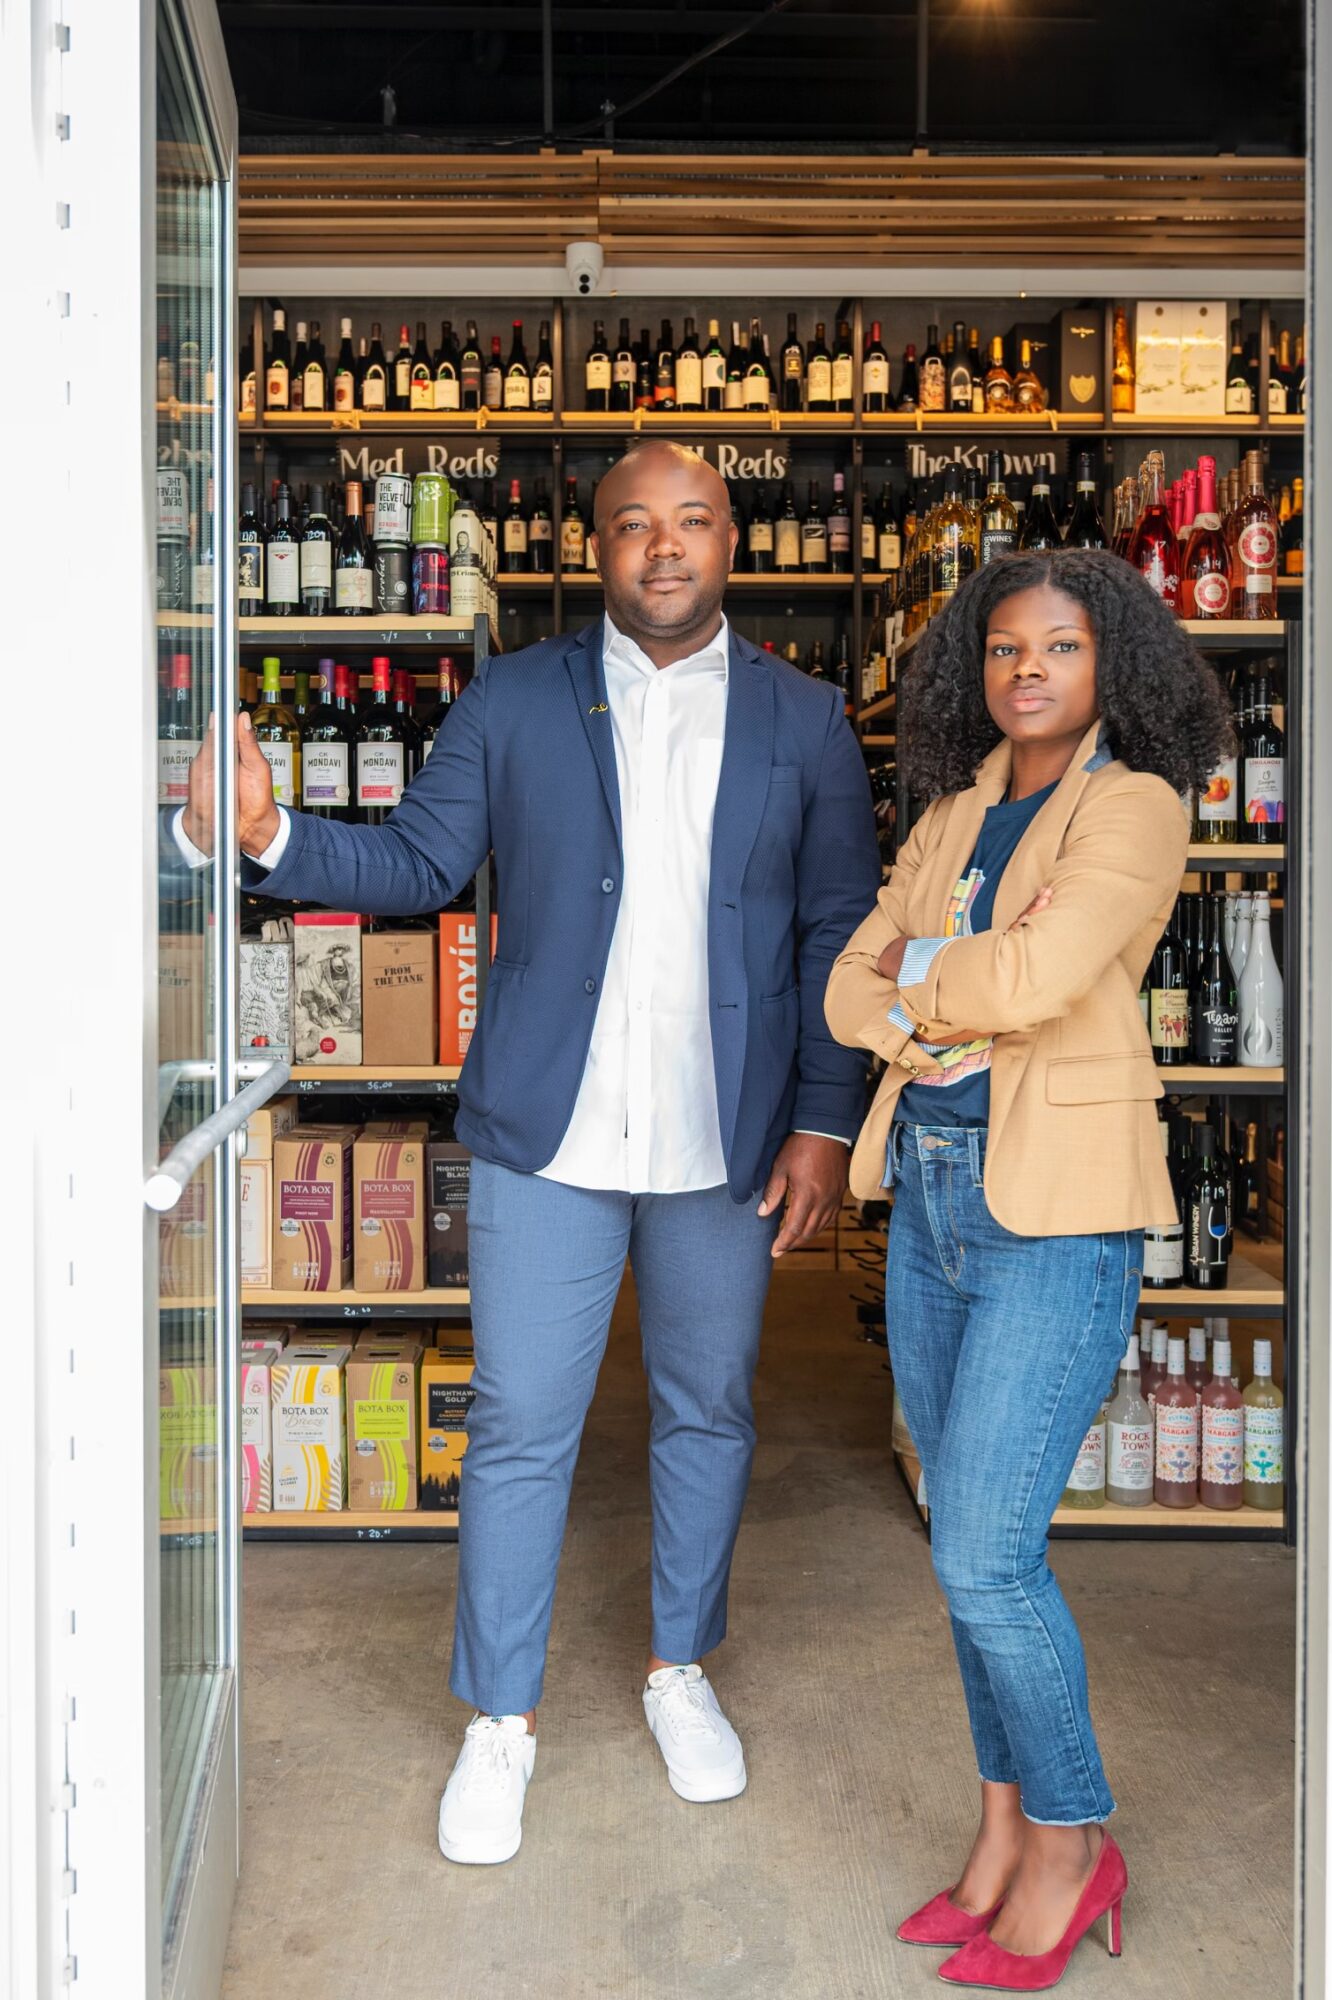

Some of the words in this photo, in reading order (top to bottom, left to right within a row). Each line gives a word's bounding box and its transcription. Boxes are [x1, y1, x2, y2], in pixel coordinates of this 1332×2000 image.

[340, 447, 404, 481] Med
[427, 445, 499, 479] Reds
[718, 444, 787, 480] Reds
[907, 444, 949, 478] The
[380, 482, 392, 492] THE
[379, 493, 404, 503] VELVET
[379, 503, 397, 512] DEVIL
[989, 535, 1013, 543] WINES
[307, 758, 342, 768] MONDAVI
[363, 758, 397, 768] MONDAVI
[384, 966, 412, 977] FROM
[373, 977, 394, 986] THE
[398, 973, 424, 984] TANK
[283, 1184, 309, 1194] BOTA
[311, 1185, 332, 1194] BOX
[364, 1183, 390, 1193] BOTA
[391, 1183, 412, 1193] BOX
[1213, 1186, 1225, 1200] 19
[282, 1407, 307, 1416] BOTA
[309, 1407, 329, 1416] BOX
[359, 1404, 384, 1413] BOTA
[386, 1404, 405, 1413] BOX
[1121, 1432, 1150, 1441] ROCK
[1081, 1442, 1102, 1451] OWN
[1121, 1442, 1151, 1451] TOWN
